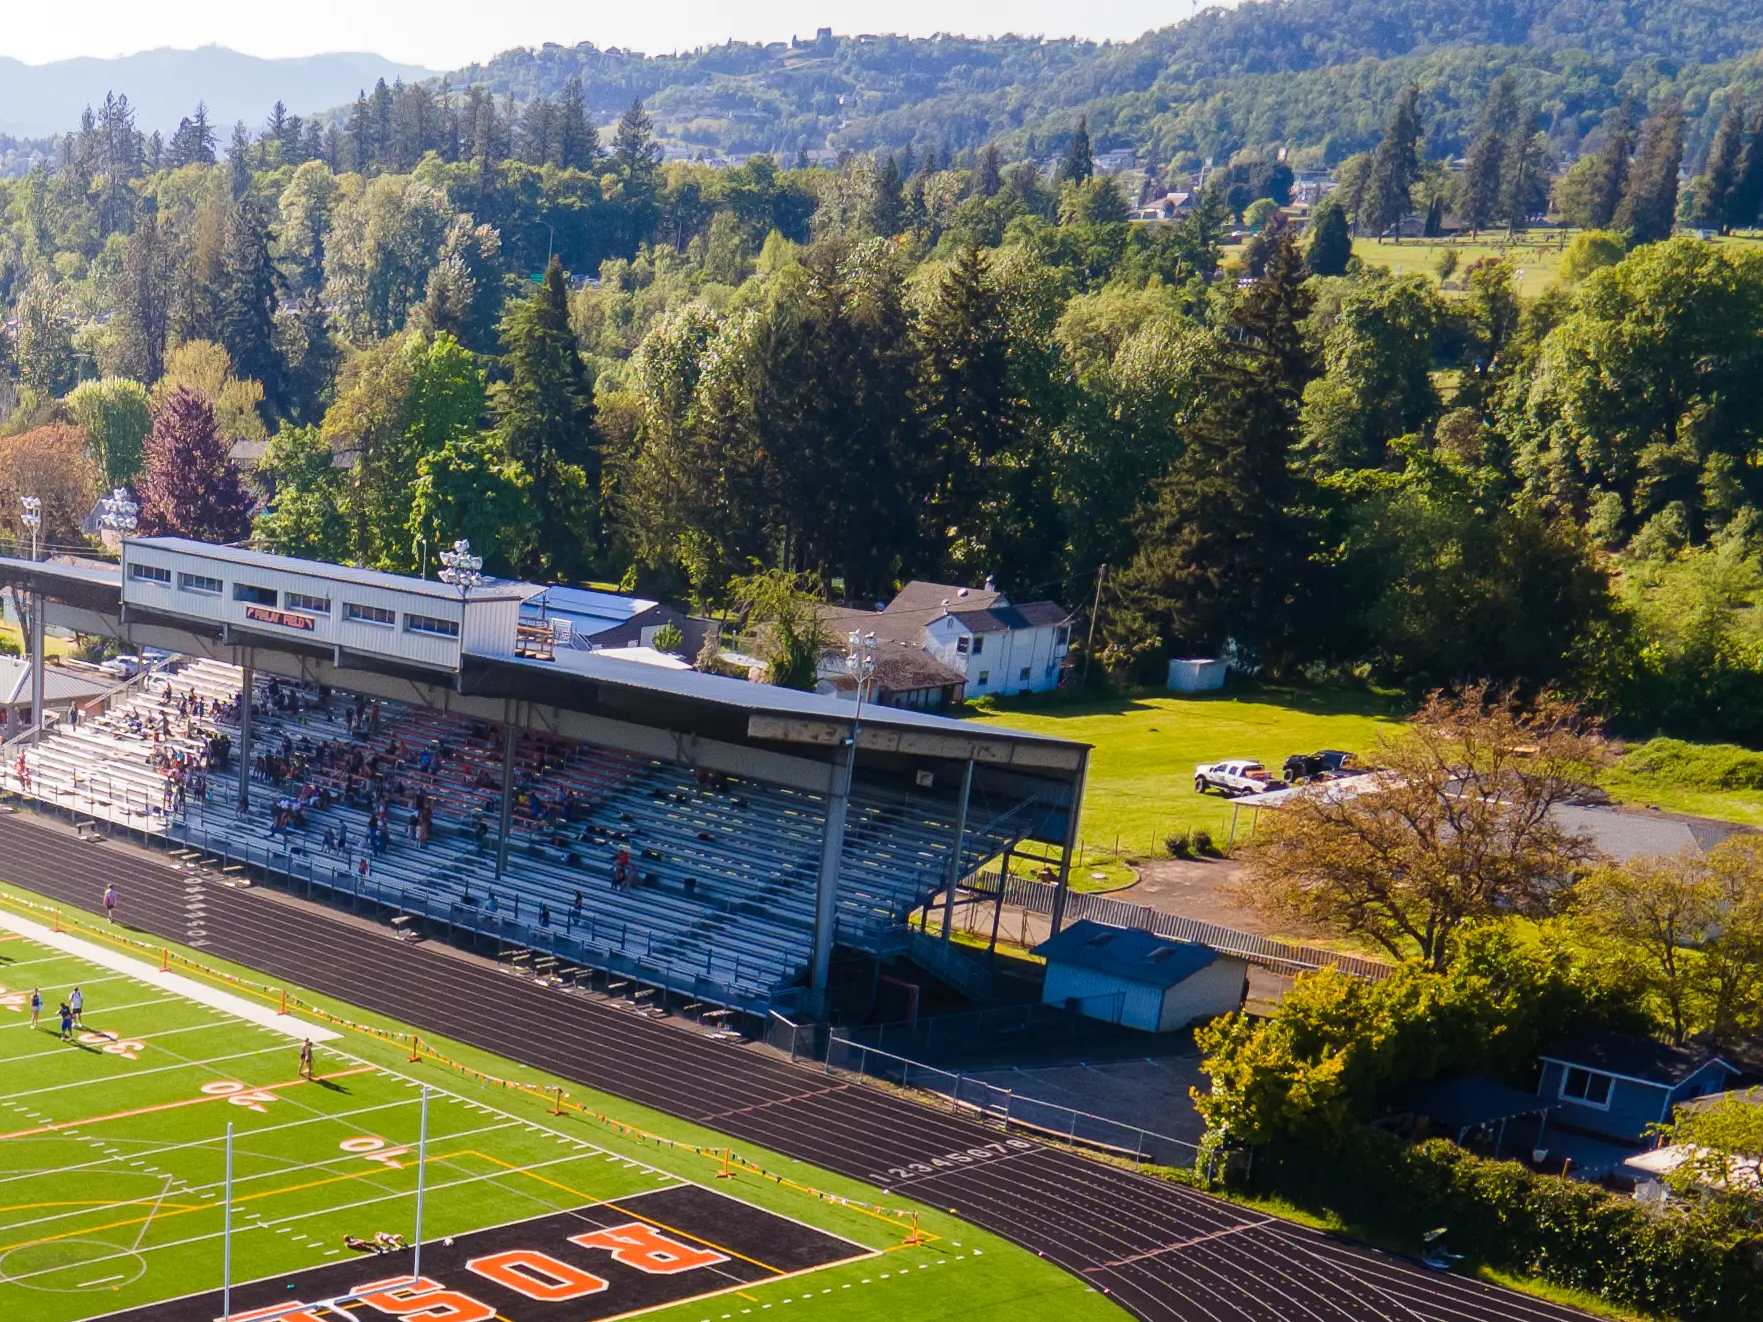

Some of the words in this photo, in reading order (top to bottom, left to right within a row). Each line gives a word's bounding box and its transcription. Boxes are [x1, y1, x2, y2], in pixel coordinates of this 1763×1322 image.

[283, 614, 305, 628] FIELD
[78, 1030, 146, 1056] 30
[200, 1080, 279, 1109] 20
[338, 1135, 410, 1163] 10
